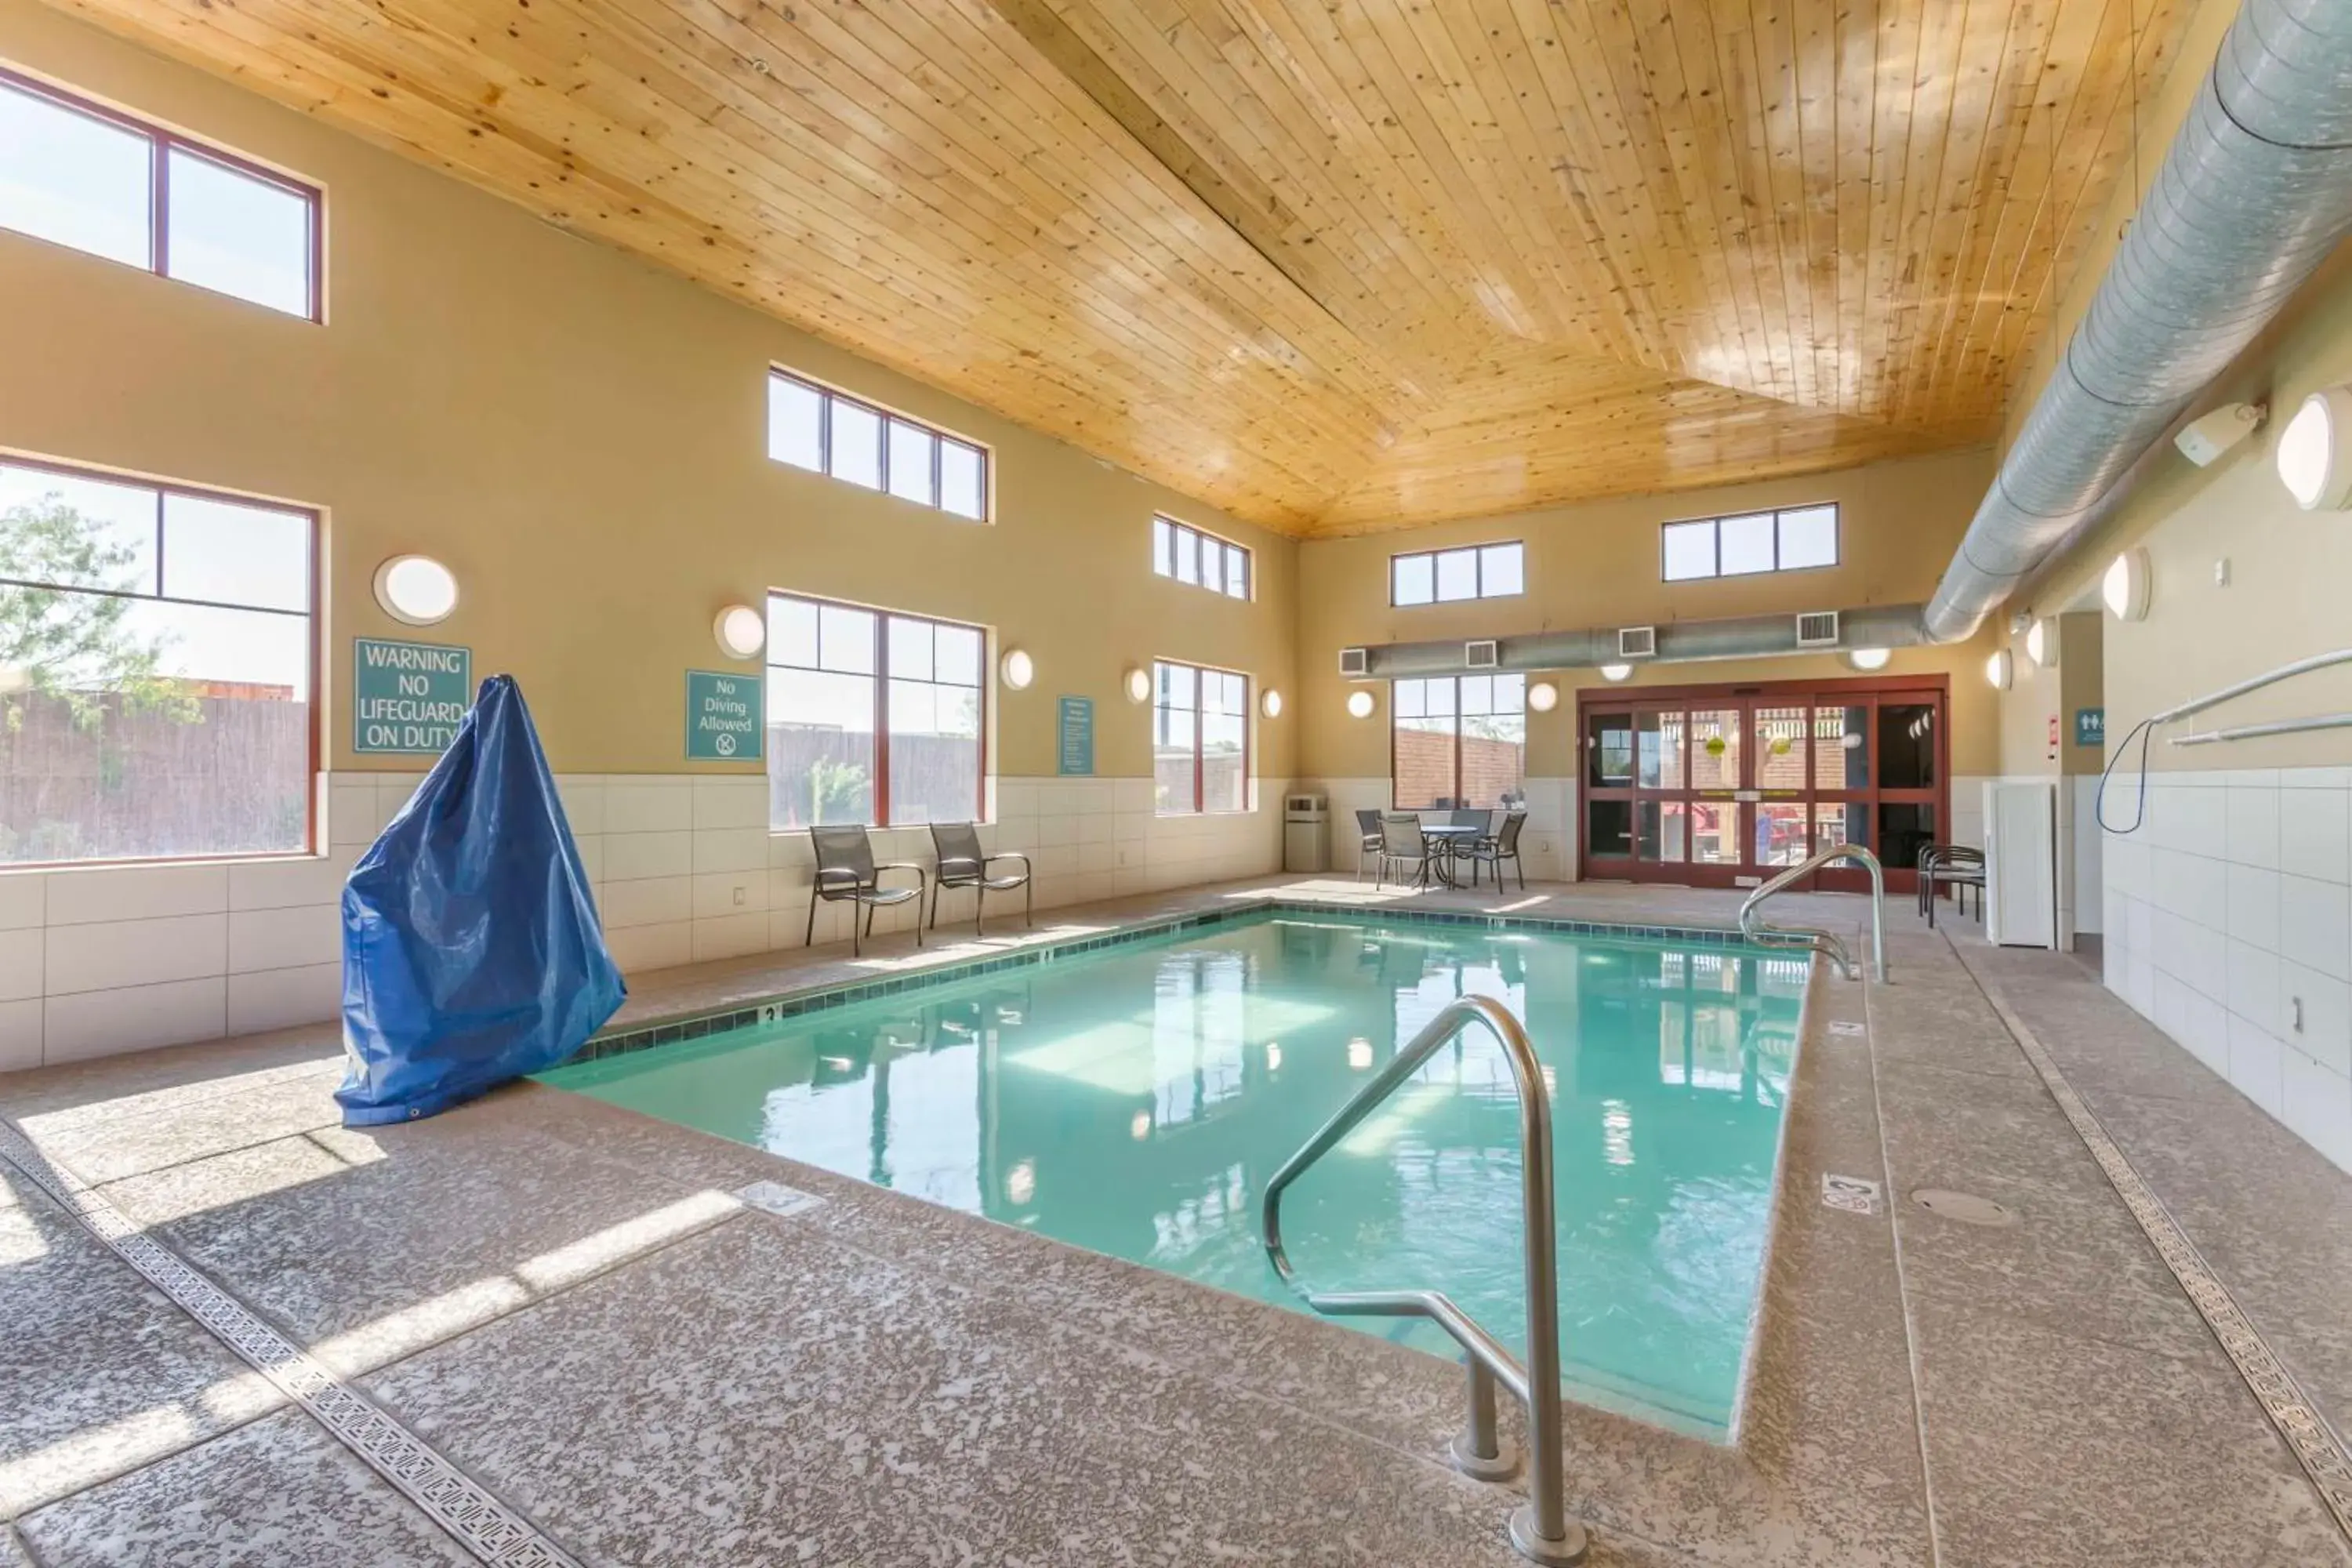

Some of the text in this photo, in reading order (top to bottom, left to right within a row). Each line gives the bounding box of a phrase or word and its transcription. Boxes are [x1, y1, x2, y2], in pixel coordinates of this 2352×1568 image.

[365, 645, 460, 673] WARNING
[399, 673, 429, 696] NO
[716, 679, 735, 695] No
[361, 698, 464, 723] LIFEGUARD
[705, 697, 746, 716] Diving
[699, 715, 752, 732] Allowed
[368, 724, 397, 746] ON
